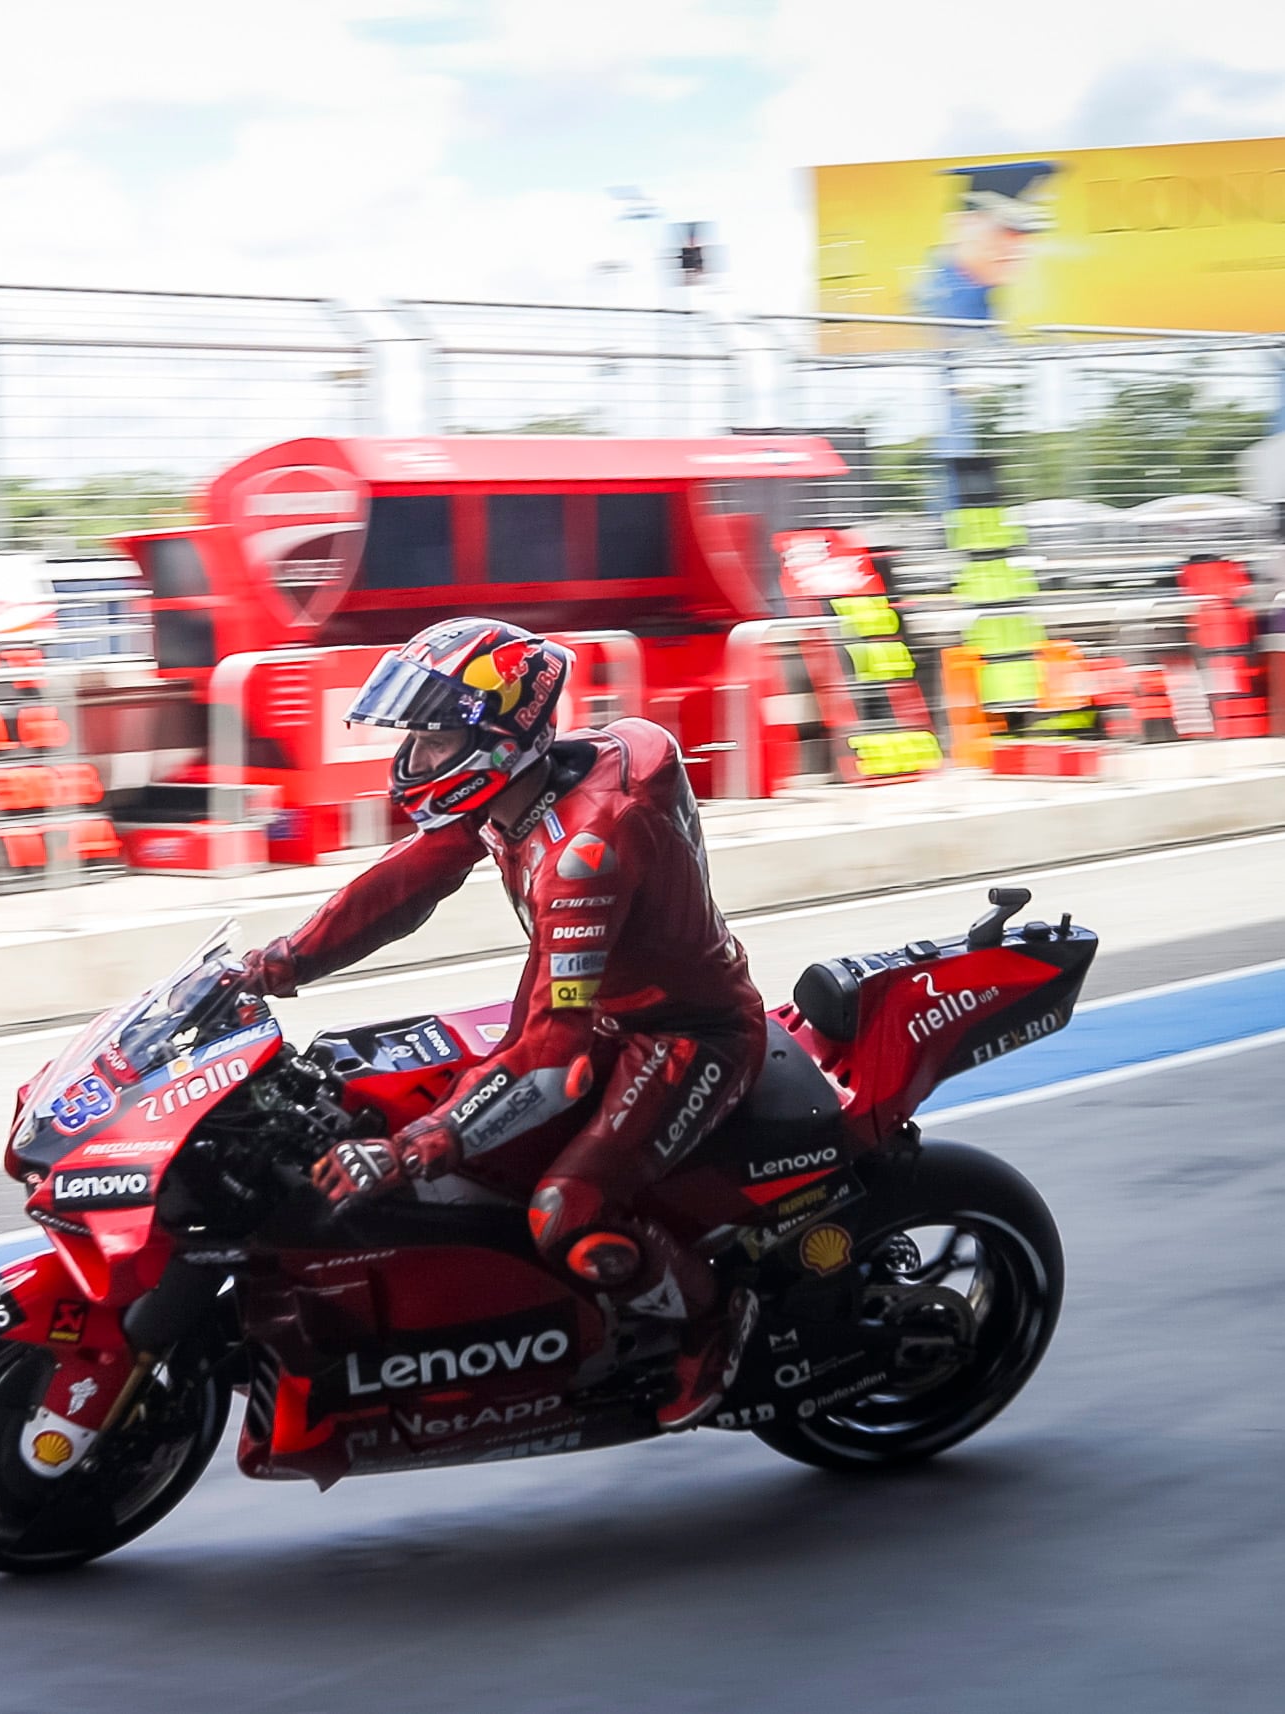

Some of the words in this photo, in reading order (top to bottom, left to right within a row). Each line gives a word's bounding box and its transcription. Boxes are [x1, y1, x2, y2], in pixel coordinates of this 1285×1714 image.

[437, 776, 485, 808] Lenovo
[508, 791, 557, 840] Lenovo
[552, 925, 606, 939] DUCATI
[907, 989, 978, 1043] riello
[978, 985, 1000, 1004] ups
[972, 1007, 1065, 1065] FLEX-BOX
[423, 1024, 451, 1056] Lenovo
[622, 1041, 668, 1106] DAIKO
[450, 1073, 508, 1124] Lenovo
[654, 1062, 722, 1157] Lenovo
[55, 1172, 148, 1200] Lenovo
[748, 1147, 838, 1179] Lenovo
[346, 1329, 569, 1396] Lenovo
[391, 1394, 563, 1443] NetApp
